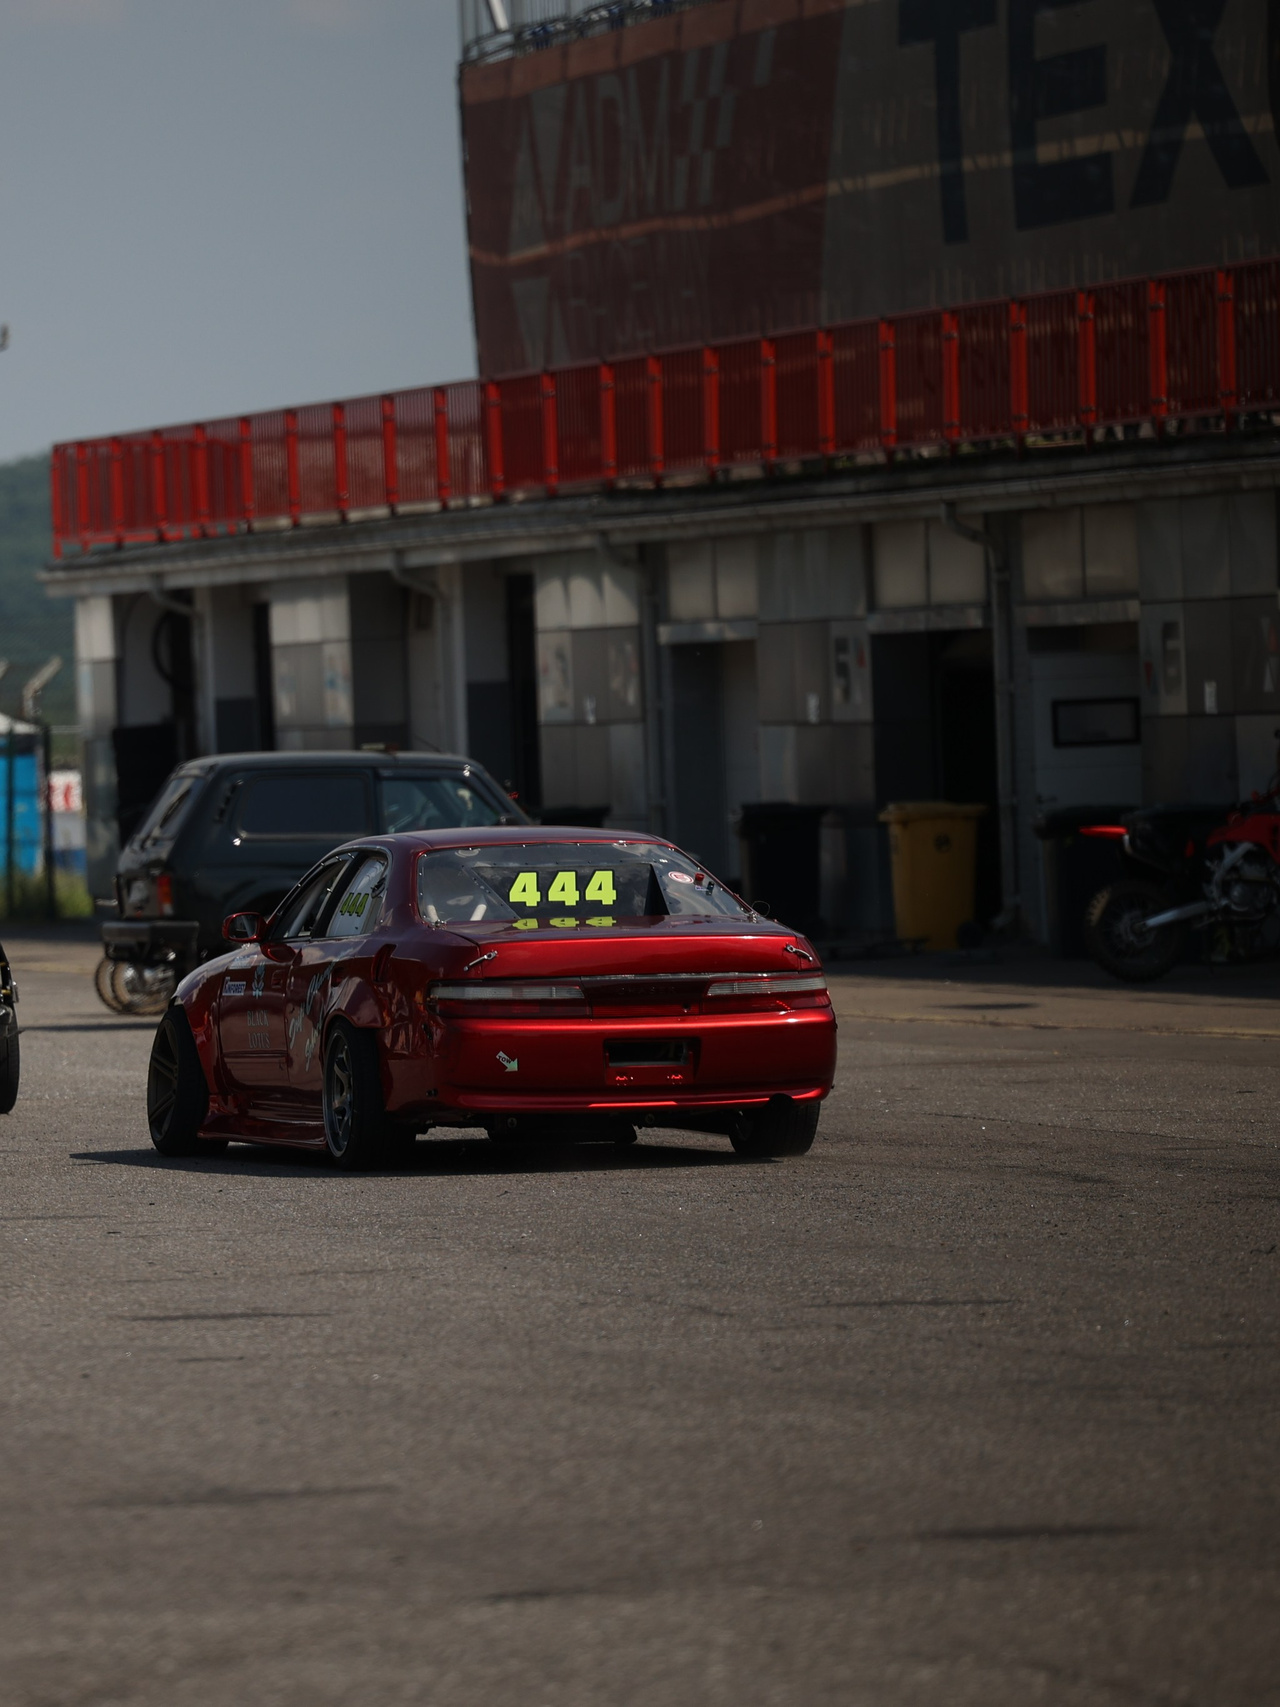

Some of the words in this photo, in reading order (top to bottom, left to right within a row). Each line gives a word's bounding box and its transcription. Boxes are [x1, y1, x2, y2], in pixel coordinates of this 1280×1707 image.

[898, 0, 1280, 244] TEX
[509, 870, 617, 907] 444
[339, 892, 369, 917] 444
[247, 1010, 269, 1026] BLACK
[248, 1032, 270, 1049] LOTUS
[498, 1055, 512, 1064] TOW
